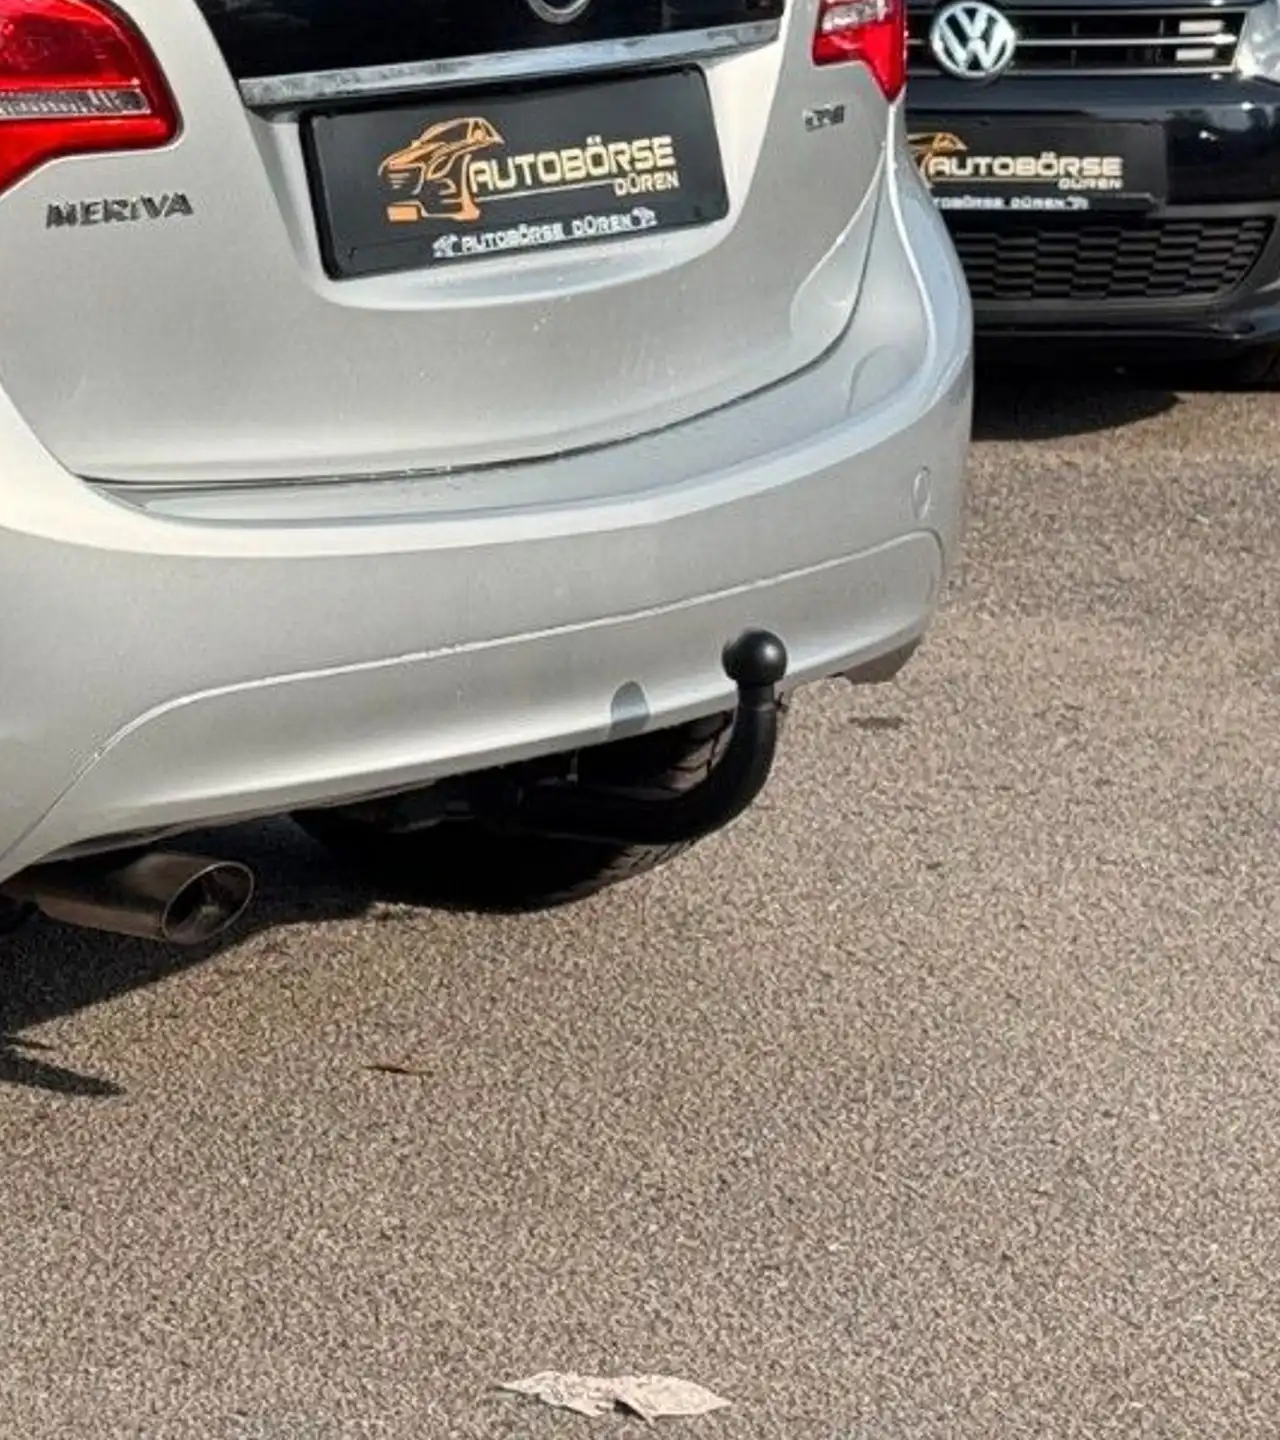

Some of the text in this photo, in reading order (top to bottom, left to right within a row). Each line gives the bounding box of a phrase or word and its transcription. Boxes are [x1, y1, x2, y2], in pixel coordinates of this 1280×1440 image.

[469, 135, 676, 193] AUTOBÖRSE
[928, 151, 1123, 177] AUTOBÖRSE
[46, 192, 194, 229] MERIVA
